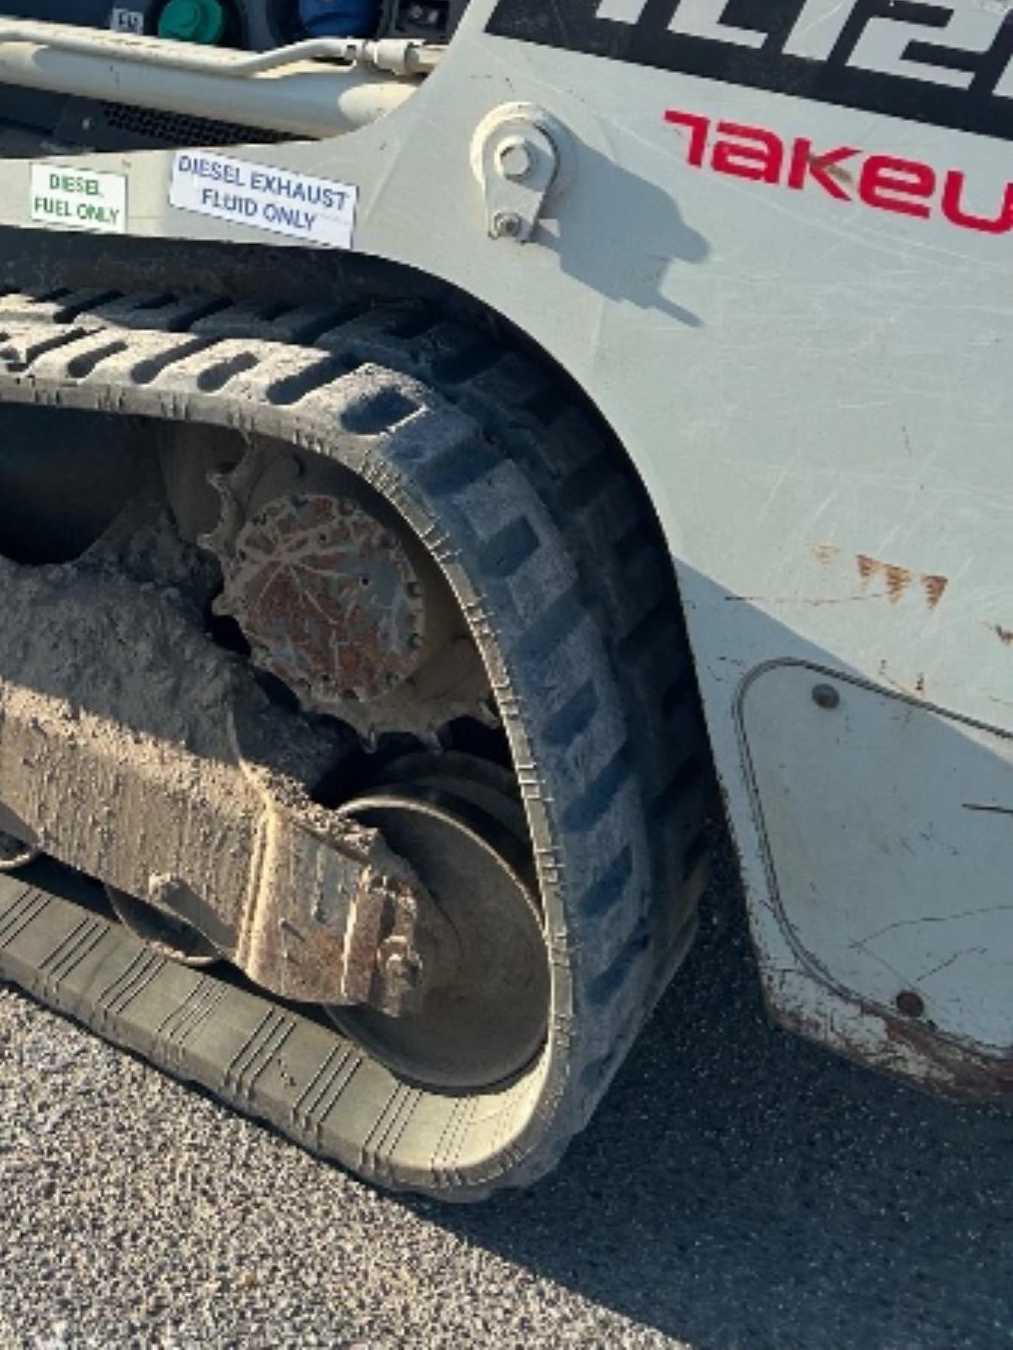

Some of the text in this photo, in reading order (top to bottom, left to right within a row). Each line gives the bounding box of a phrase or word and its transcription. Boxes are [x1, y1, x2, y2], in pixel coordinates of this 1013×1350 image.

[49, 173, 102, 197] DIESEL
[178, 155, 348, 211] DIESEL EXHAUST
[34, 196, 120, 226] FUEL ONLY
[201, 188, 316, 231] FLUID ONLY
